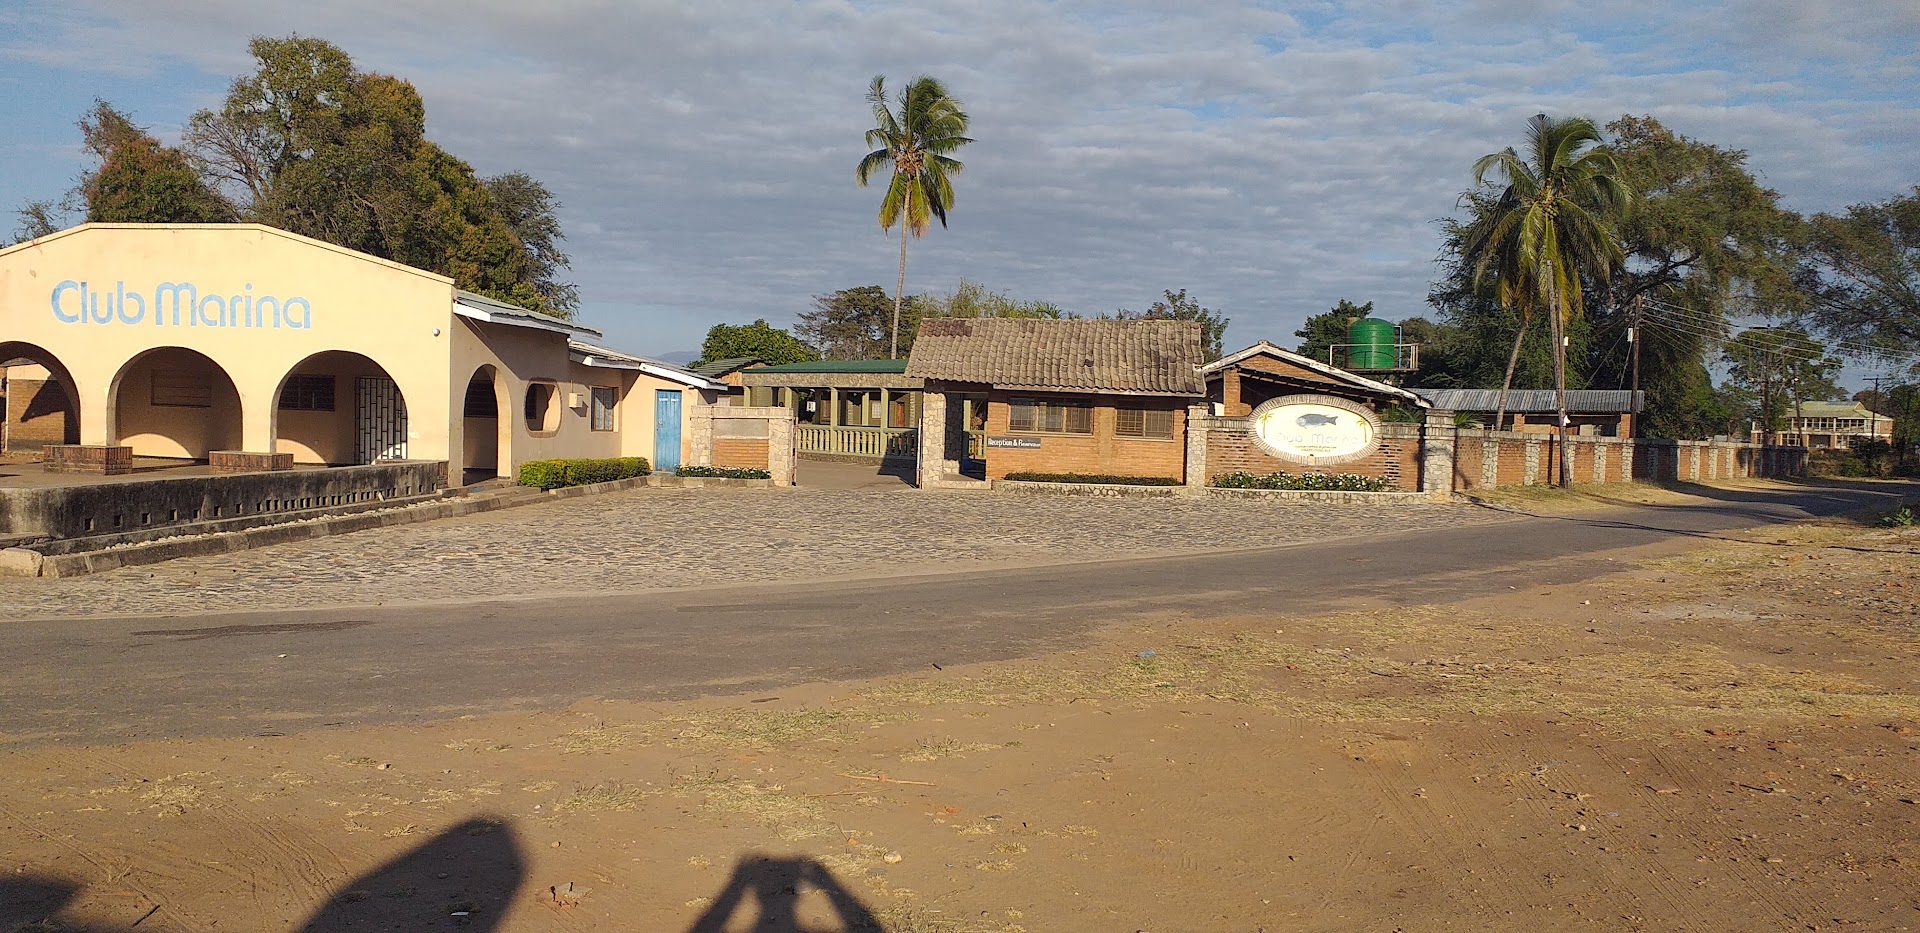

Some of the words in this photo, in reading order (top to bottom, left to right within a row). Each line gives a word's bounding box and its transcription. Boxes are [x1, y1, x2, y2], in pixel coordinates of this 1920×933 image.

[51, 280, 145, 324] Club
[155, 282, 311, 328] Marina
[988, 438, 1012, 447] Reception
[1312, 433, 1358, 444] Marna
